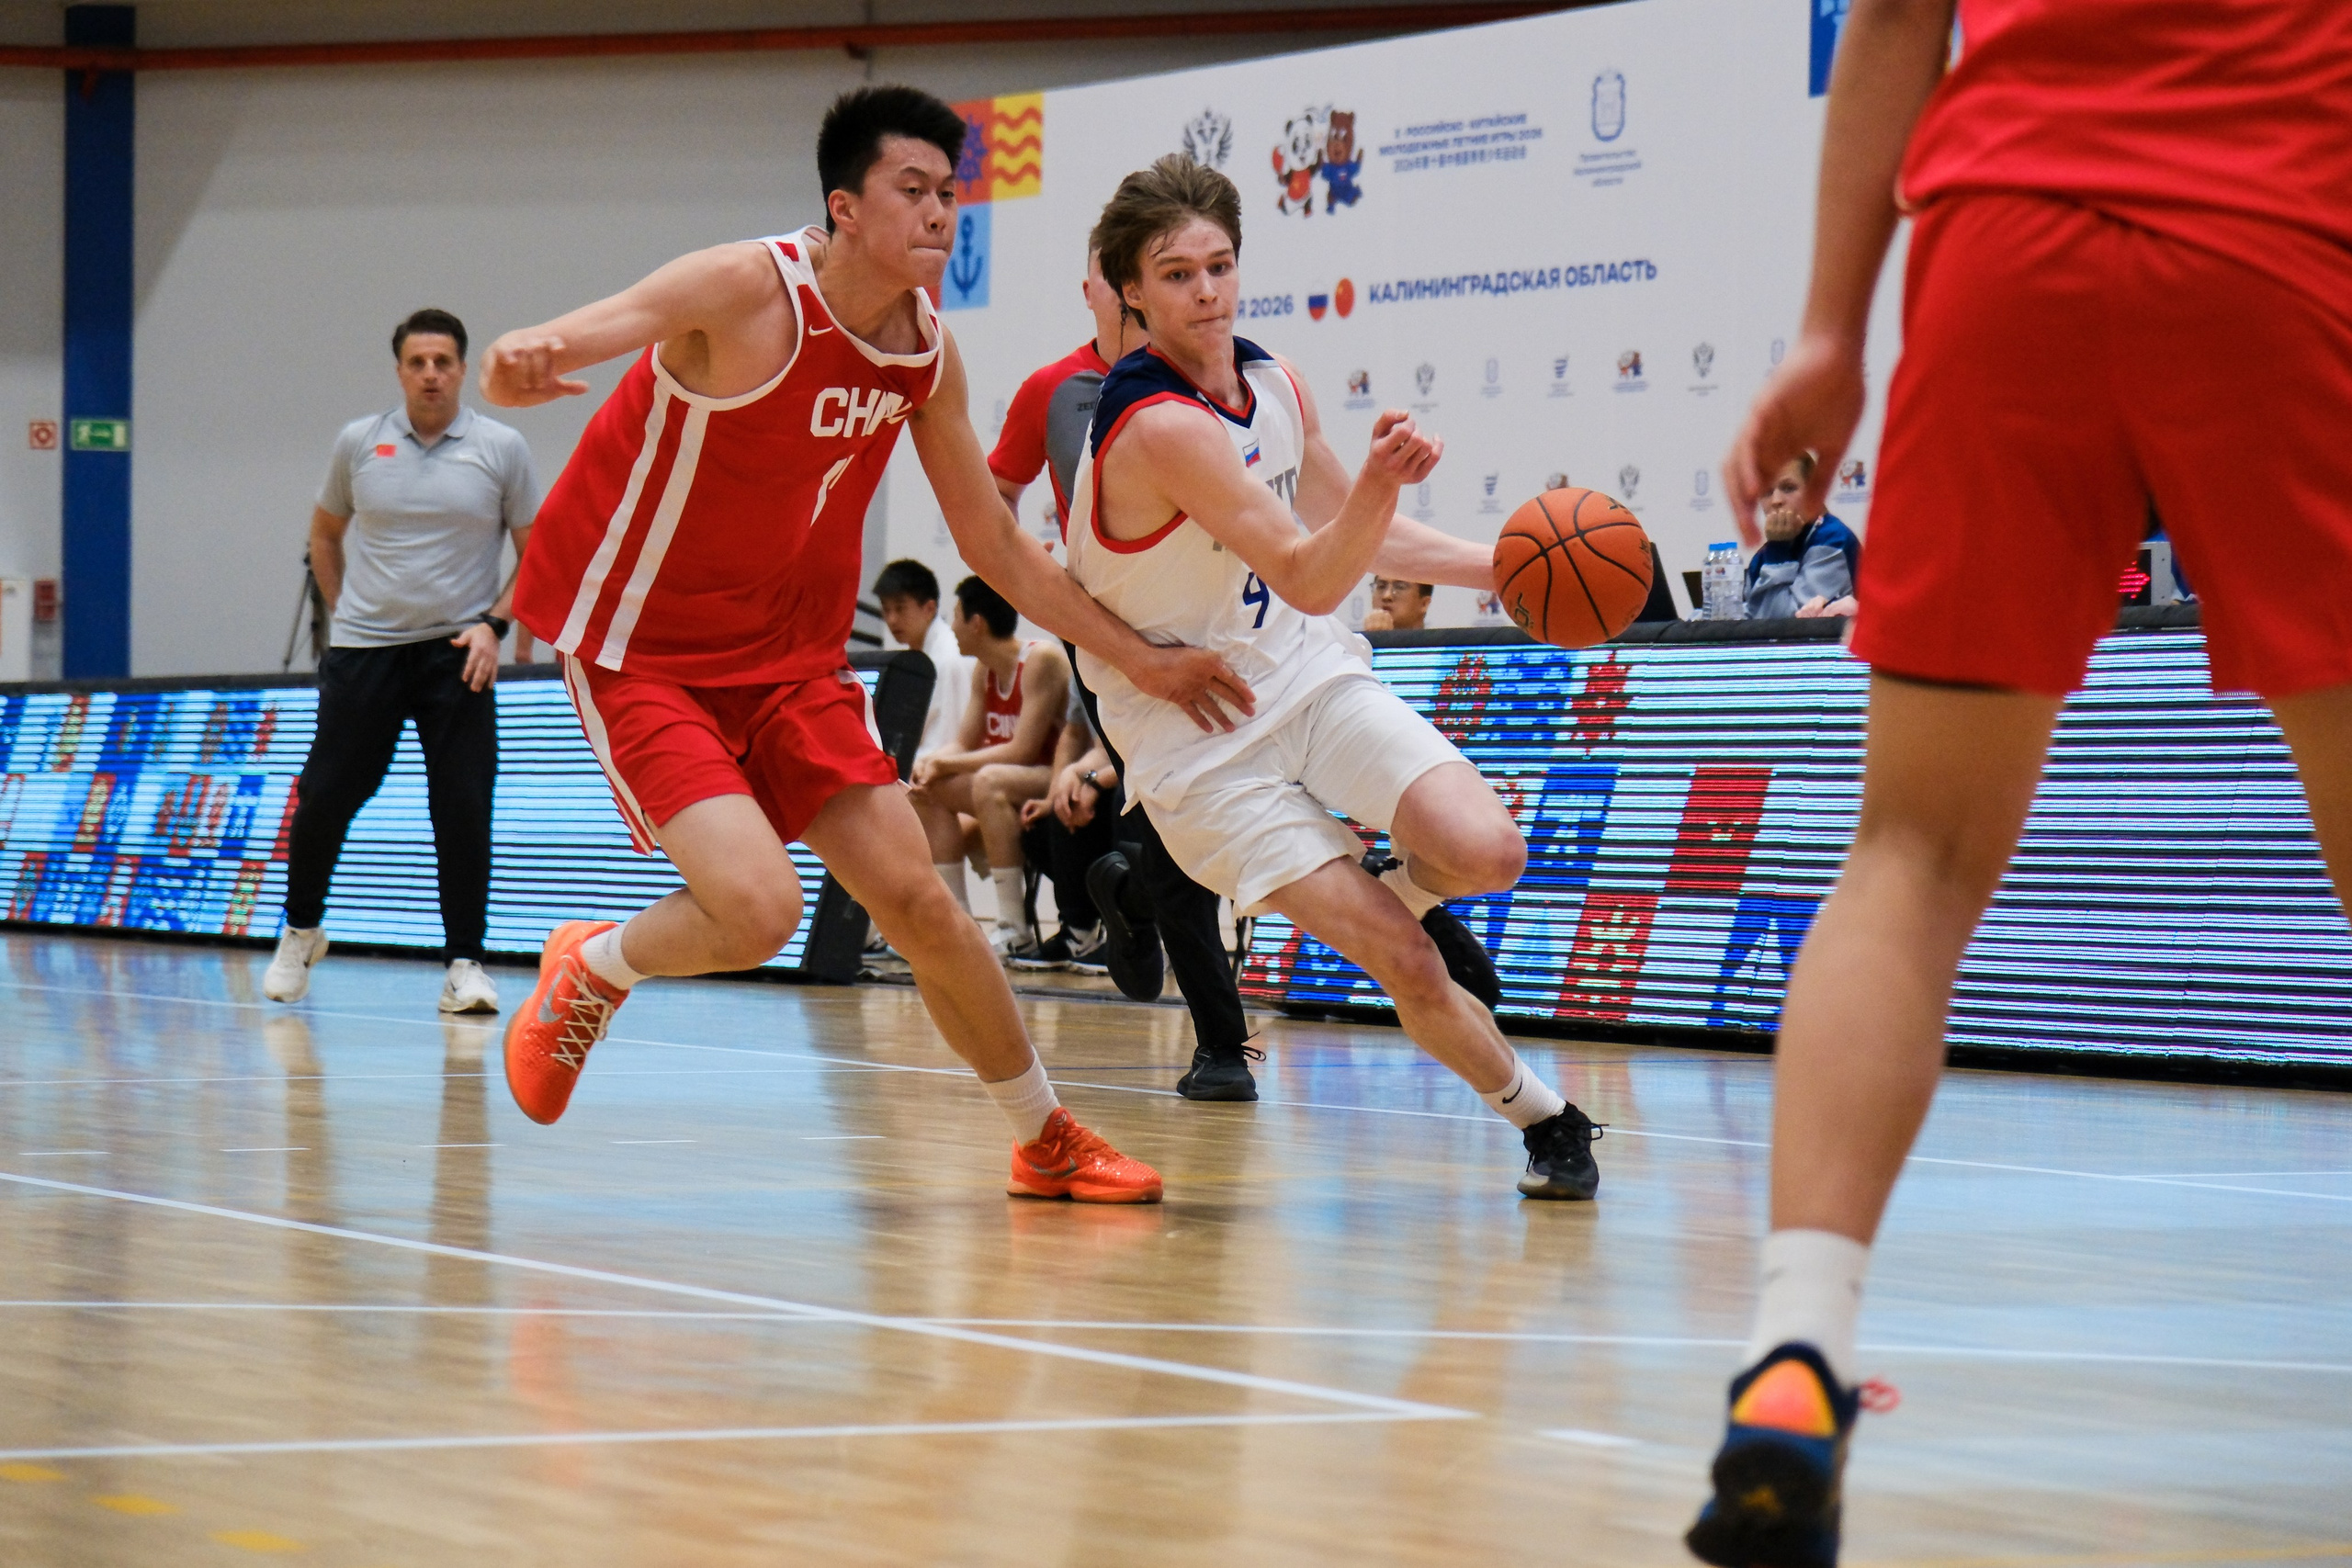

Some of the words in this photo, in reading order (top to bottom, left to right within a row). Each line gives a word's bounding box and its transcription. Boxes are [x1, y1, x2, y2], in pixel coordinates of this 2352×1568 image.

[1250, 294, 1294, 319] 2026
[1369, 267, 1561, 304] КАЛИНИНГРАДСКАЯ
[1565, 259, 1658, 288] ОБЛАСТЬ
